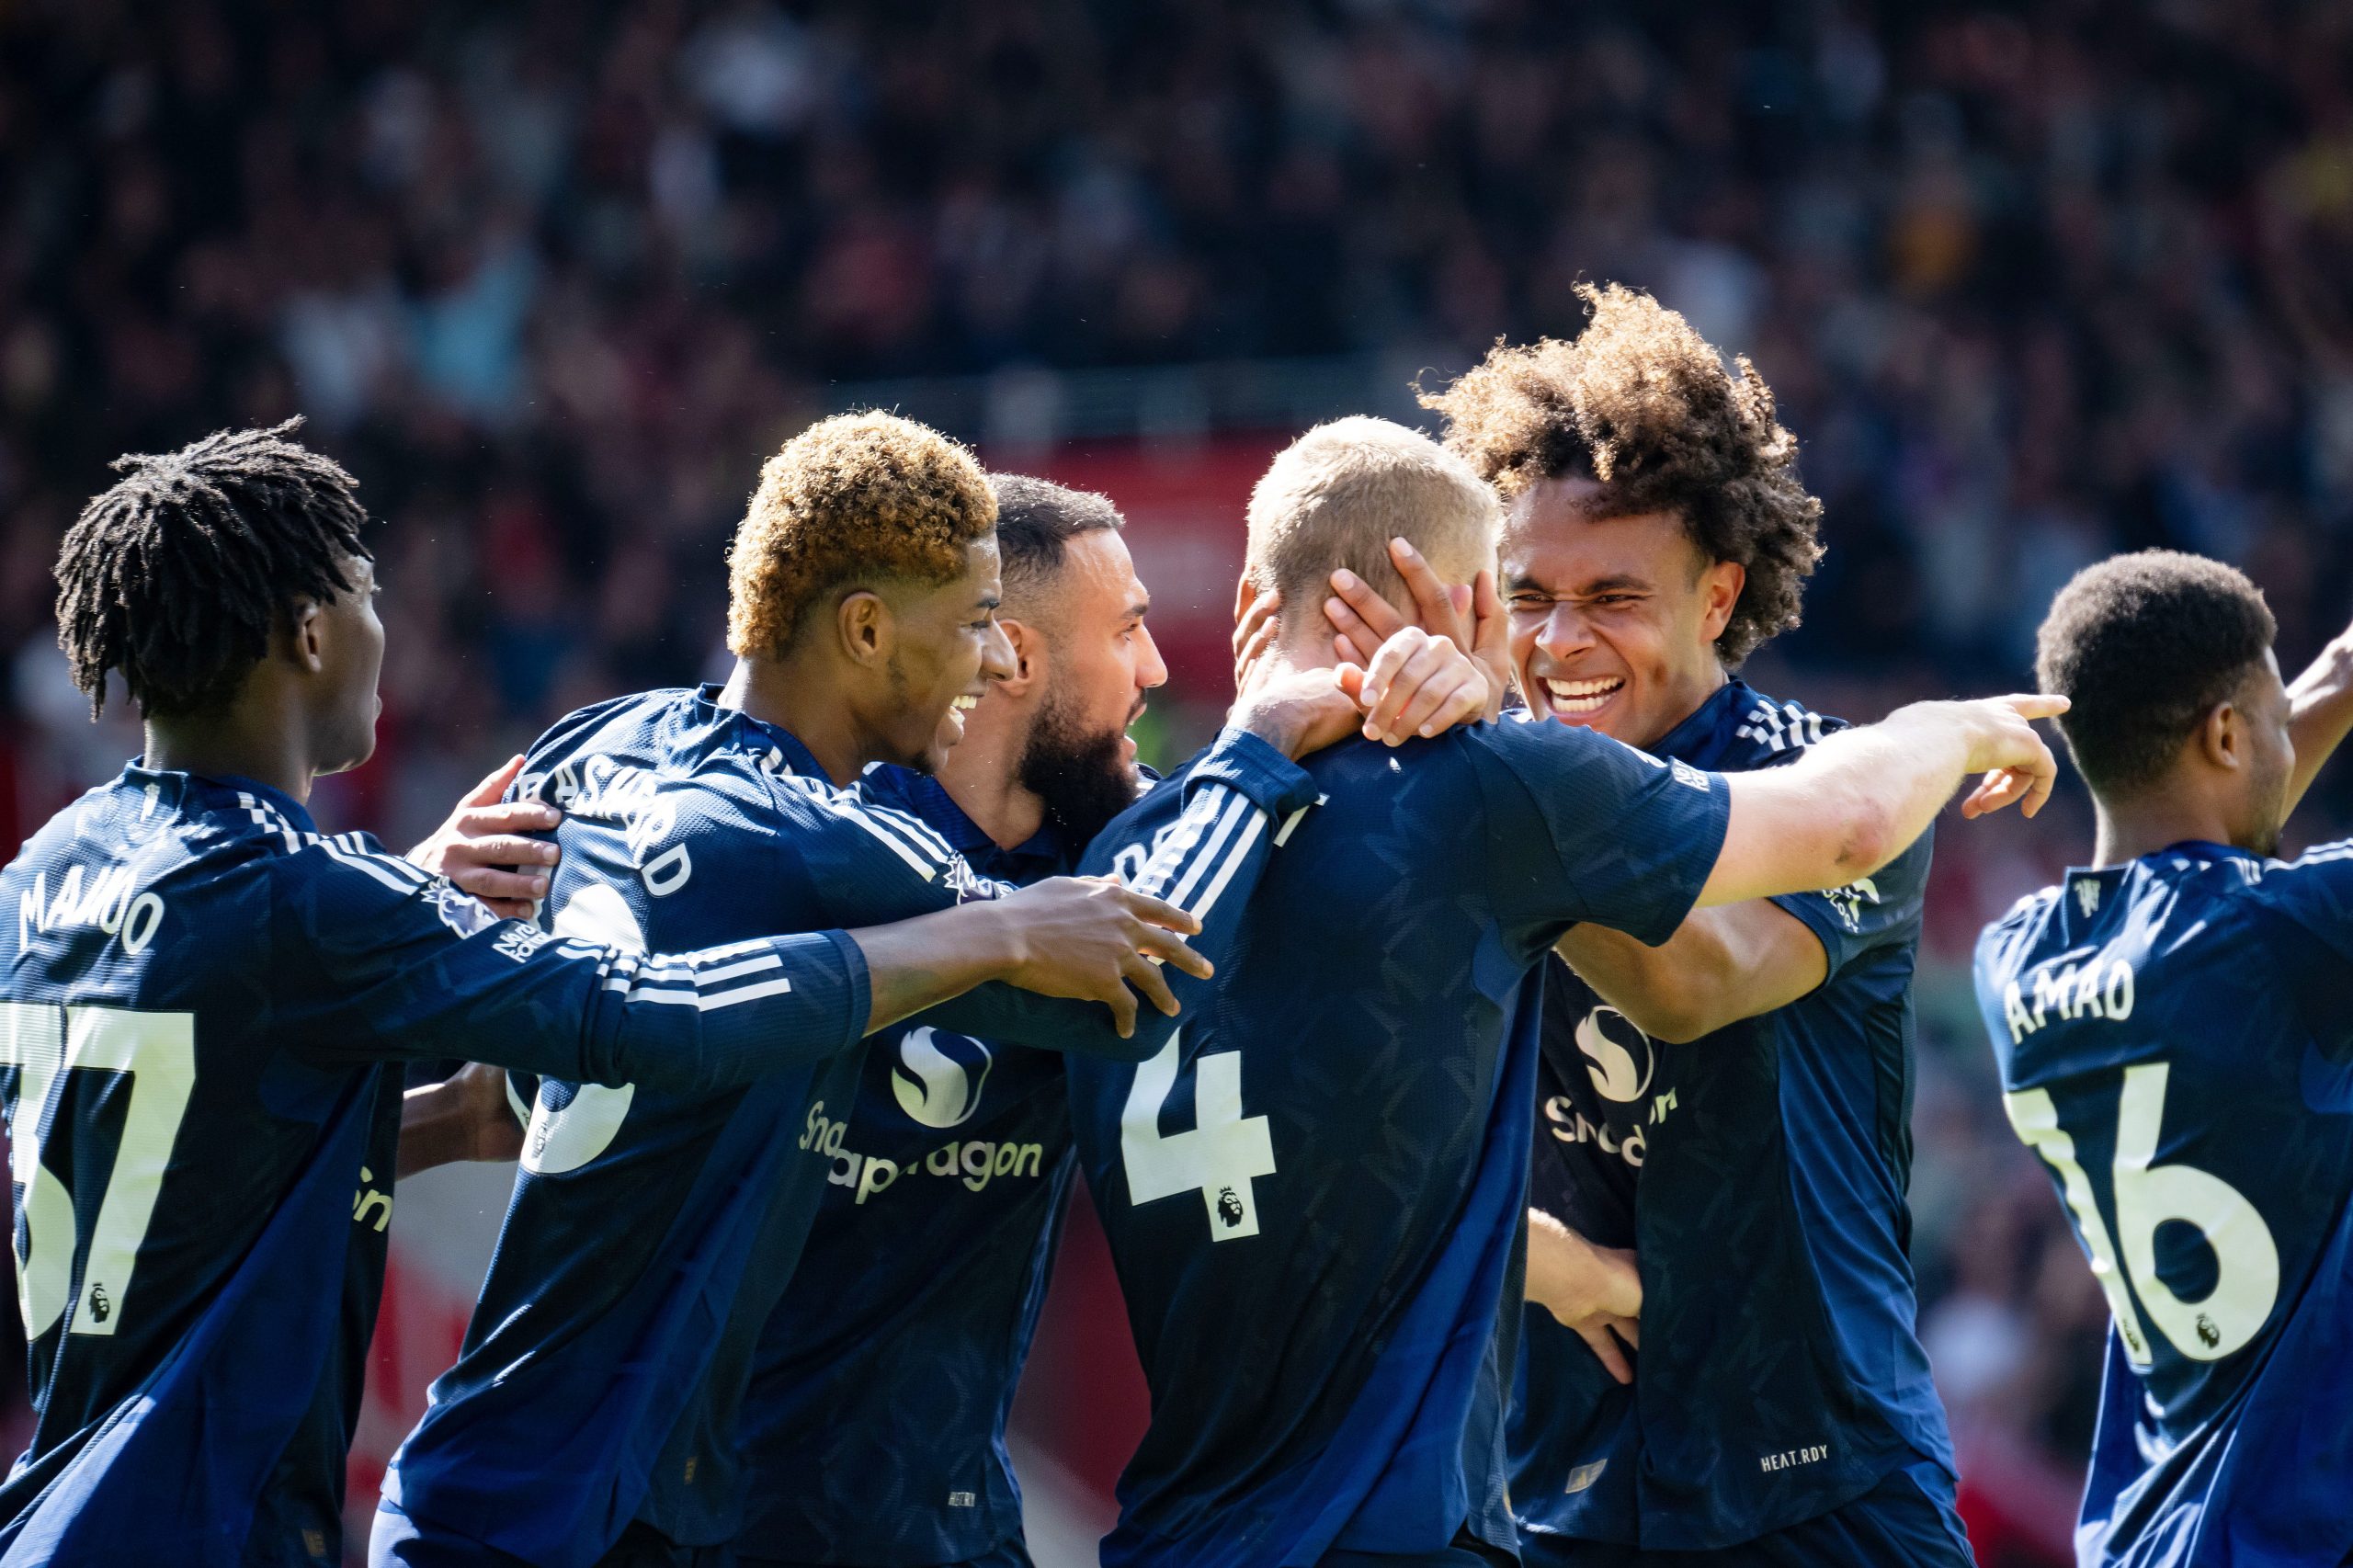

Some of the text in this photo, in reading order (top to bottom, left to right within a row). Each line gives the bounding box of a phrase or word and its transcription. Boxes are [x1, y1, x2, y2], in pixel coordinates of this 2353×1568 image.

[2005, 959, 2135, 1045] AMAD
[1121, 1025, 1277, 1243] 4
[2003, 1062, 2280, 1369] 16
[1760, 1444, 1827, 1472] HEAT.RDY
